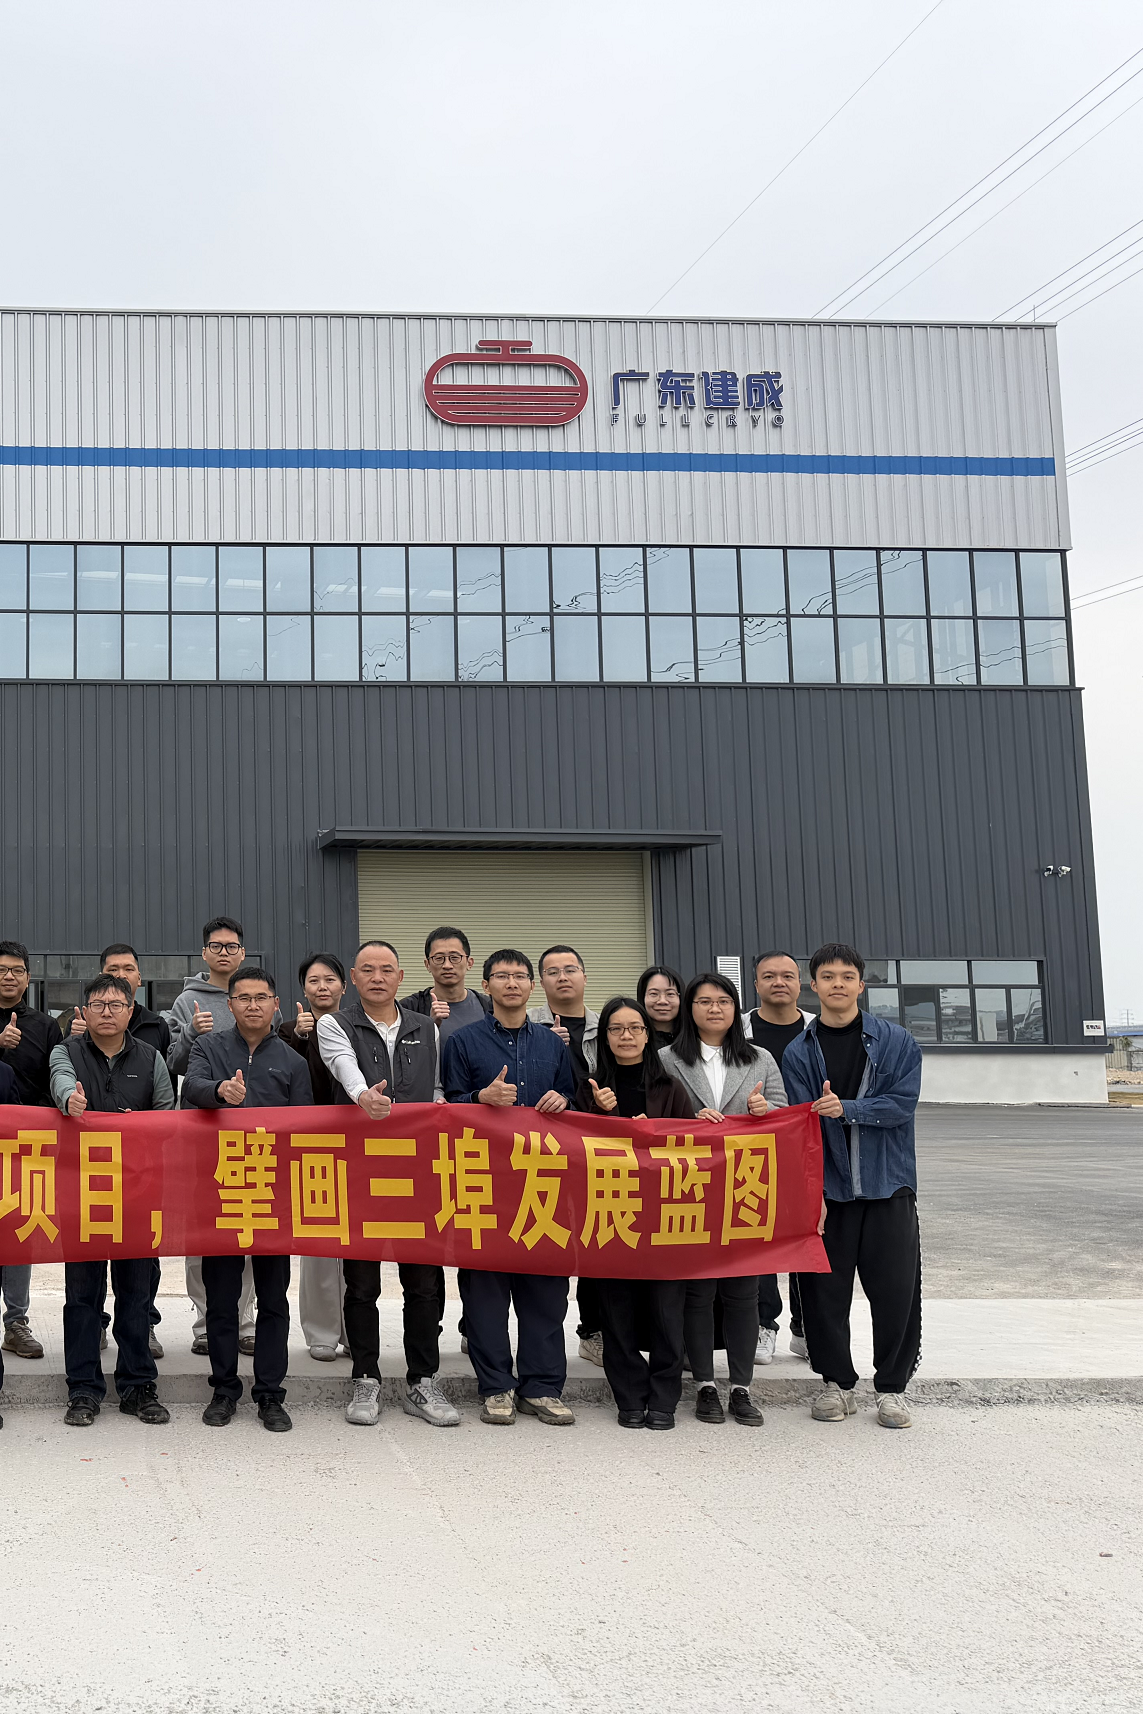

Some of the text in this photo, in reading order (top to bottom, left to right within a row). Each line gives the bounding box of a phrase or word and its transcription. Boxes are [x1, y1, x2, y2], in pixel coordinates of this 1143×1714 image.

[612, 370, 784, 409] 广东建成
[611, 413, 785, 426] FULLCRYO
